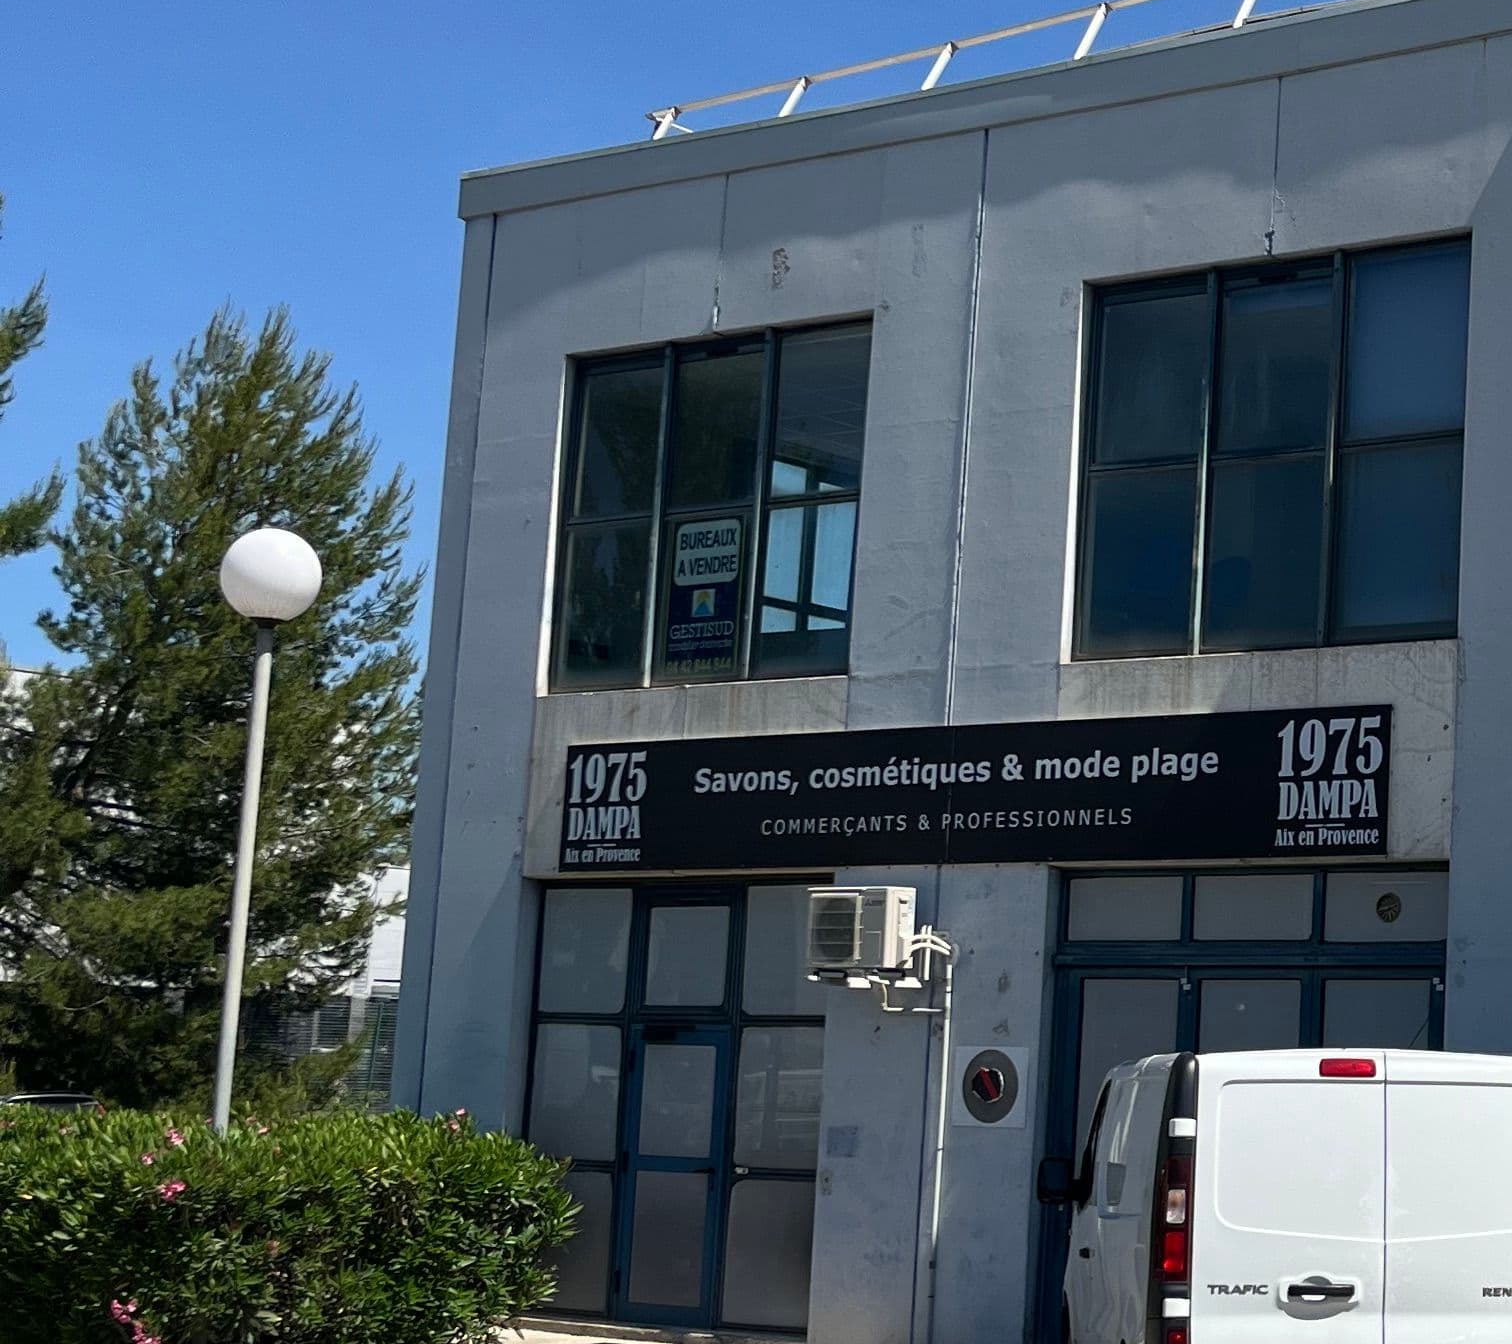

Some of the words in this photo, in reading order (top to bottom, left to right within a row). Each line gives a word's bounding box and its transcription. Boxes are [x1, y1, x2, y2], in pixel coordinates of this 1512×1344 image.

[680, 528, 738, 551] BUREAUX
[678, 560, 686, 577] A
[689, 555, 737, 576] VENDRE
[1278, 715, 1383, 777] 1975
[569, 751, 647, 803] 1975
[694, 768, 799, 795] Savons,
[809, 757, 991, 790] cosmétiques
[1001, 754, 1024, 781] &
[1035, 750, 1121, 780] mode
[1131, 747, 1219, 783] plage
[1277, 779, 1378, 820] DAMPA
[567, 805, 641, 840] DAMPA
[761, 814, 907, 836] COMMERÇANTS
[918, 814, 930, 831] &
[941, 808, 1132, 830] PROFESSIONNELS
[1275, 829, 1295, 846] Aix
[1298, 830, 1314, 846] en
[1318, 828, 1379, 846] Provence
[564, 848, 580, 864] Aix
[582, 849, 594, 863] en
[595, 847, 641, 863] Provence
[1207, 1284, 1269, 1295] TRAFIC
